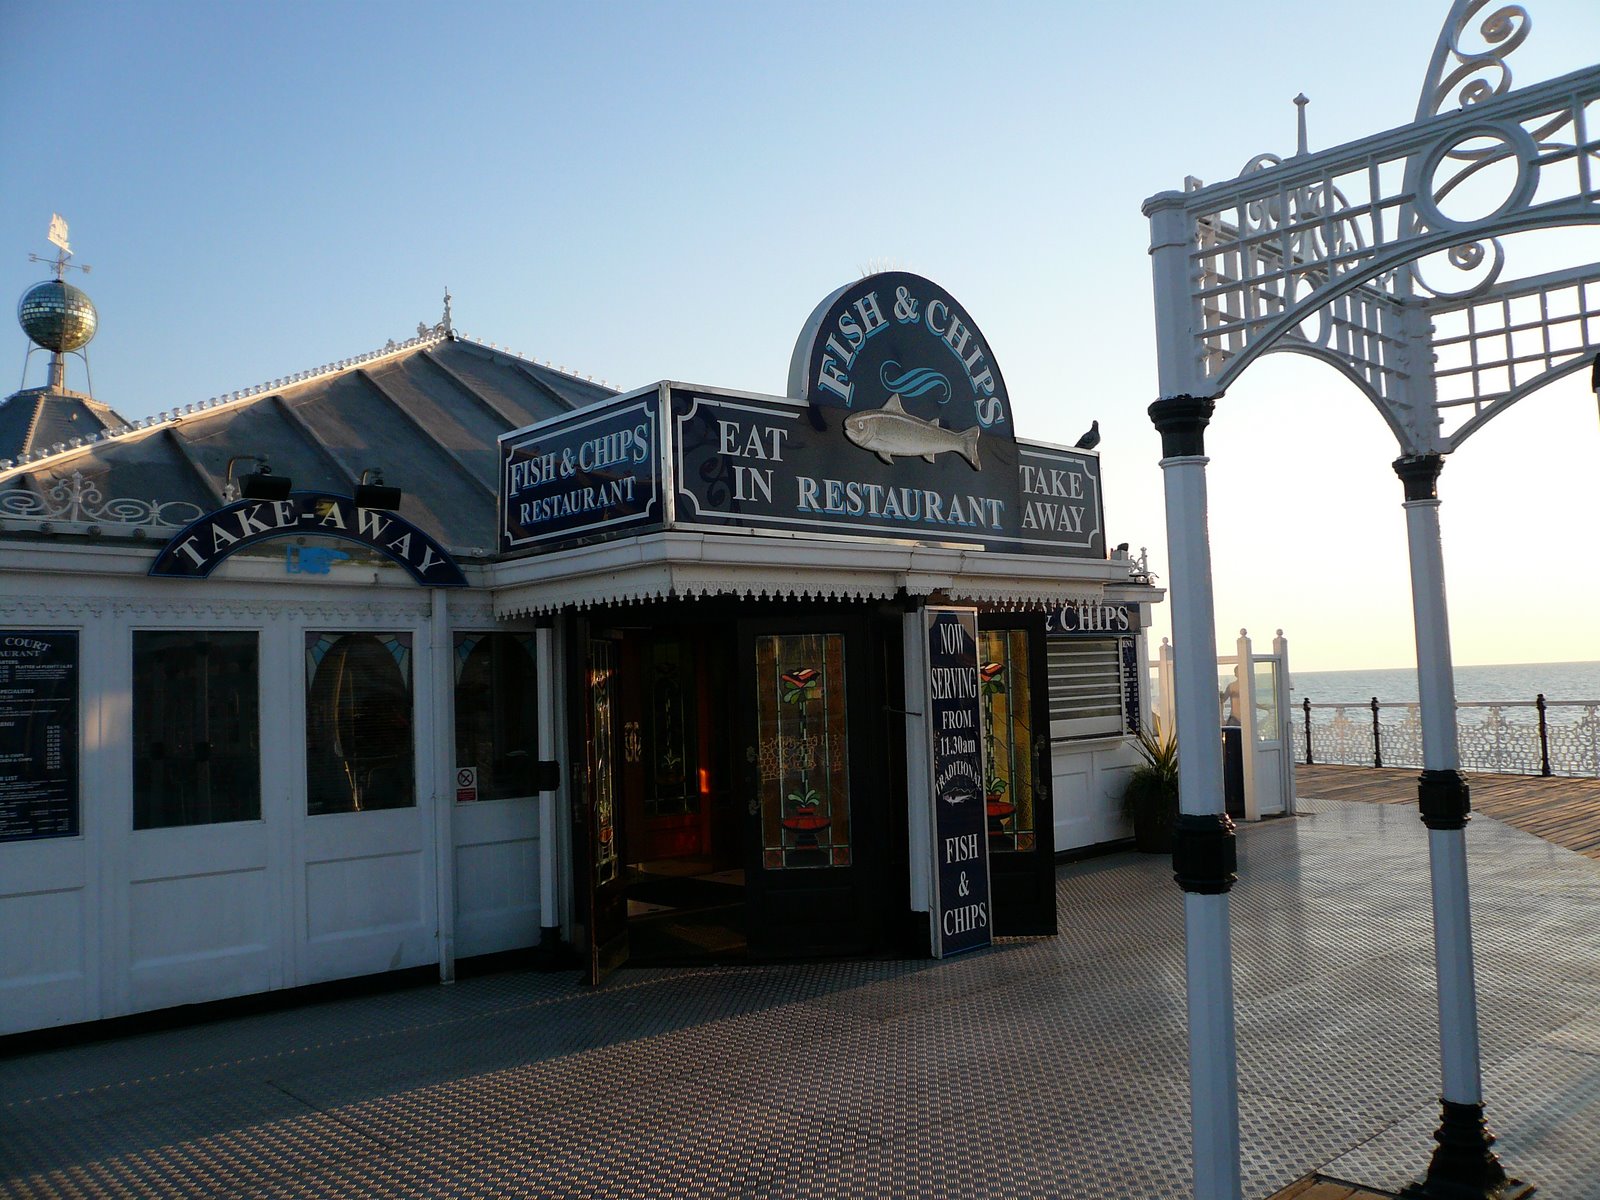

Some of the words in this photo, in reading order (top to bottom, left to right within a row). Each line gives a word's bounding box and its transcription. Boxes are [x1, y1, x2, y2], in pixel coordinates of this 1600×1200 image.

[818, 291, 890, 408] FISH
[893, 286, 920, 325] &
[924, 299, 1004, 428] CHIPS
[717, 420, 787, 461] EAT
[509, 451, 557, 499] FISH
[560, 447, 577, 479] &
[579, 422, 649, 473] CHIPS
[732, 465, 774, 503] IN
[1019, 464, 1084, 500] TAKE
[520, 475, 636, 526] RESTAURANT
[796, 475, 1004, 530] RESTAURANT
[1021, 500, 1085, 533] AWAY
[172, 498, 446, 576] TAKE-AWAY
[1060, 604, 1130, 631] CHIPS
[4, 637, 52, 651] COURT
[940, 623, 965, 655] NOW
[931, 667, 977, 700] SERVING
[940, 735, 976, 757] 11.30am
[935, 760, 982, 795] TRADITIONAL
[945, 833, 979, 864] FISH
[958, 870, 970, 897] &
[943, 902, 987, 936] CHIPS
